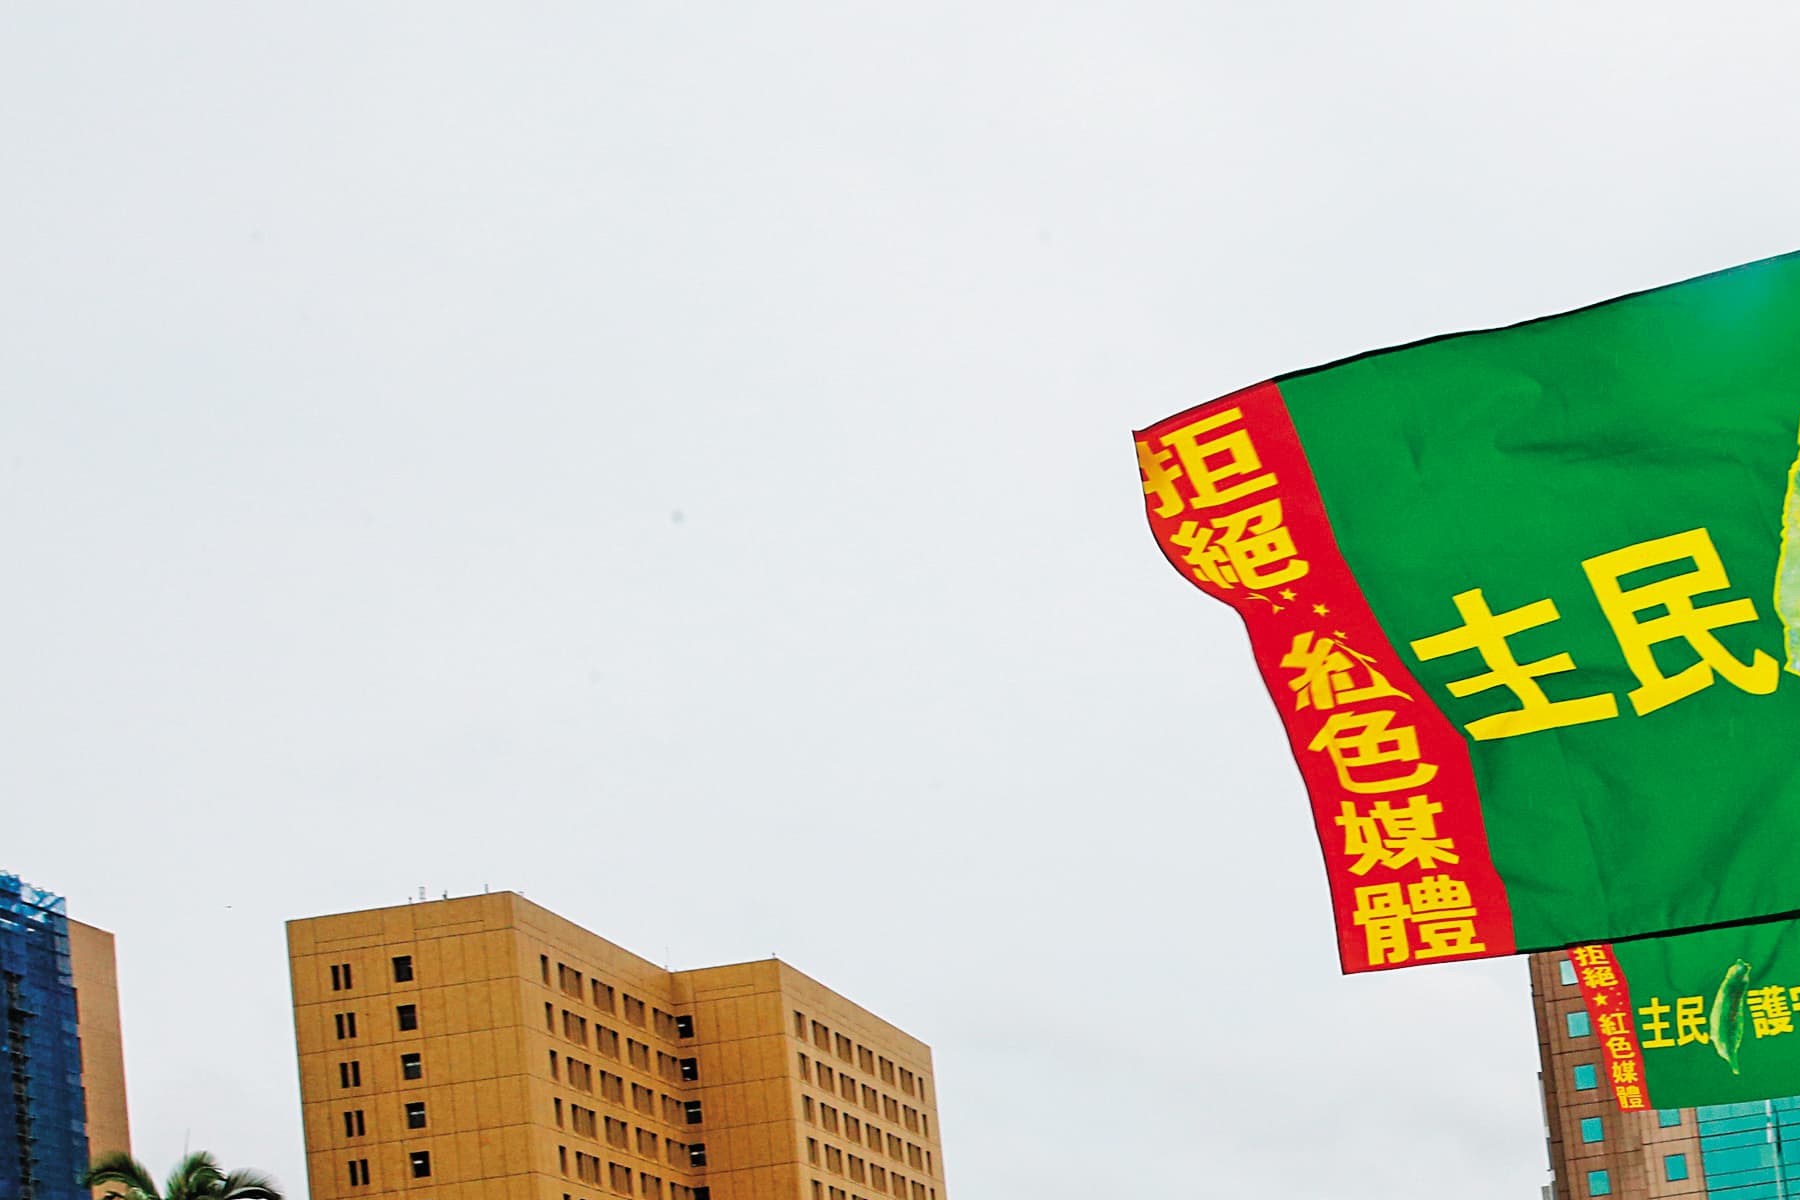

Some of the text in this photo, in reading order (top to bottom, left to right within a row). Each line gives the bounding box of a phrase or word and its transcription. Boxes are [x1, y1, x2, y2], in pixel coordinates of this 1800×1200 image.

[1139, 406, 1486, 966] 拒絕 紅色媒體
[1572, 944, 1646, 1110] 拒絕 紅色媒體
